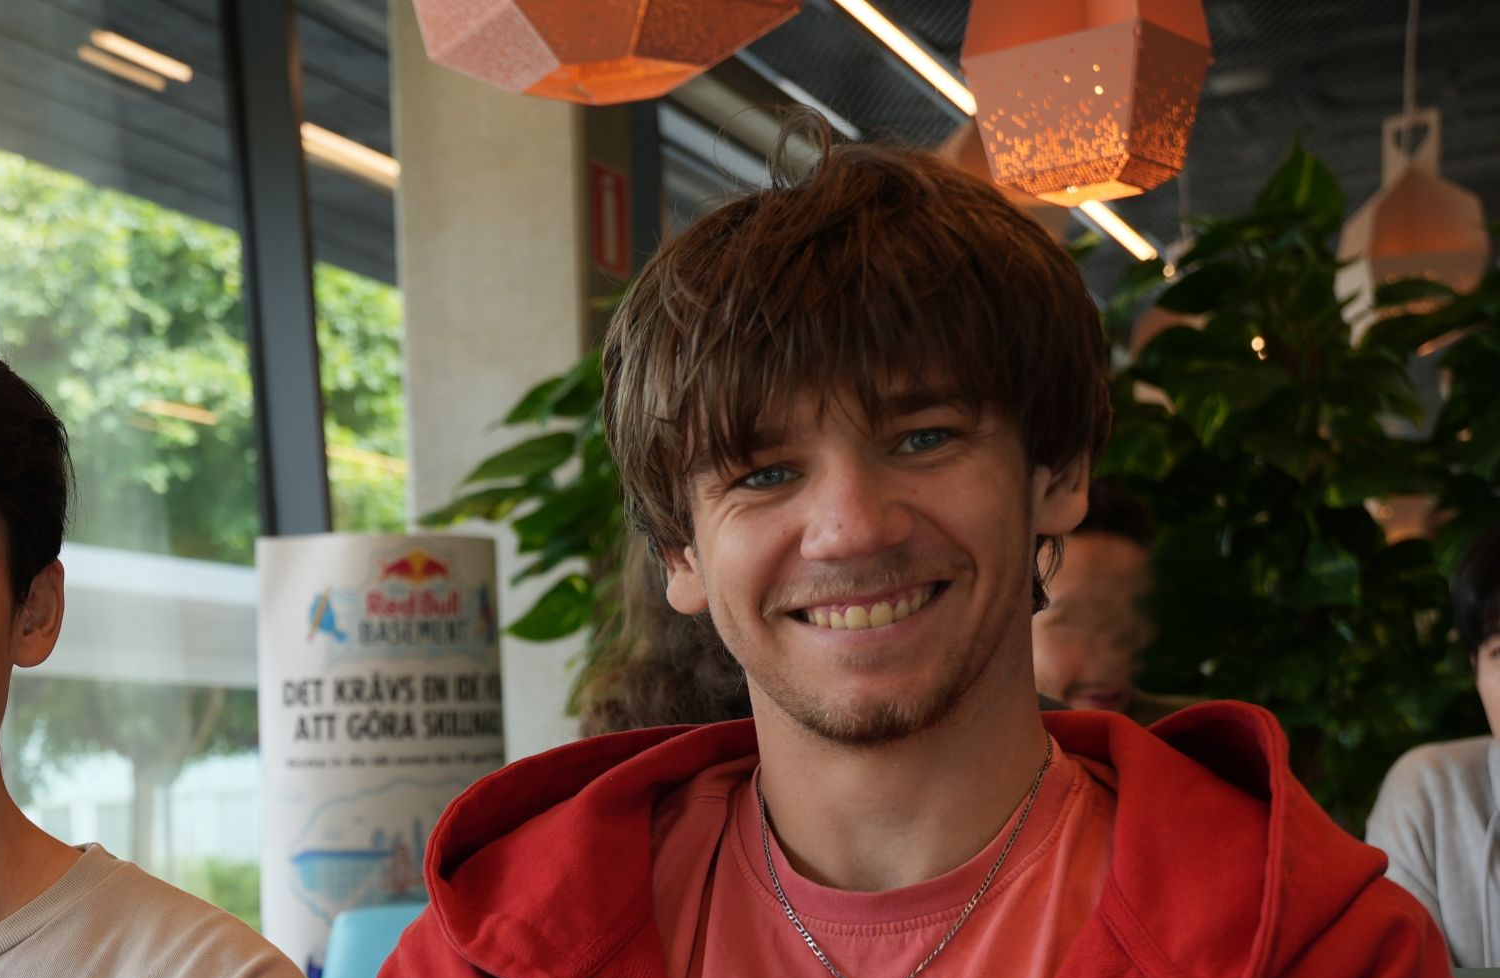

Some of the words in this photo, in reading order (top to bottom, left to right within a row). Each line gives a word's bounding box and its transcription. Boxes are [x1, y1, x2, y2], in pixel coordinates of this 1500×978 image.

[366, 589, 415, 617] Red
[419, 588, 459, 617] Bull
[282, 677, 323, 707] DET
[421, 673, 450, 704] EN
[293, 713, 336, 741] ATT
